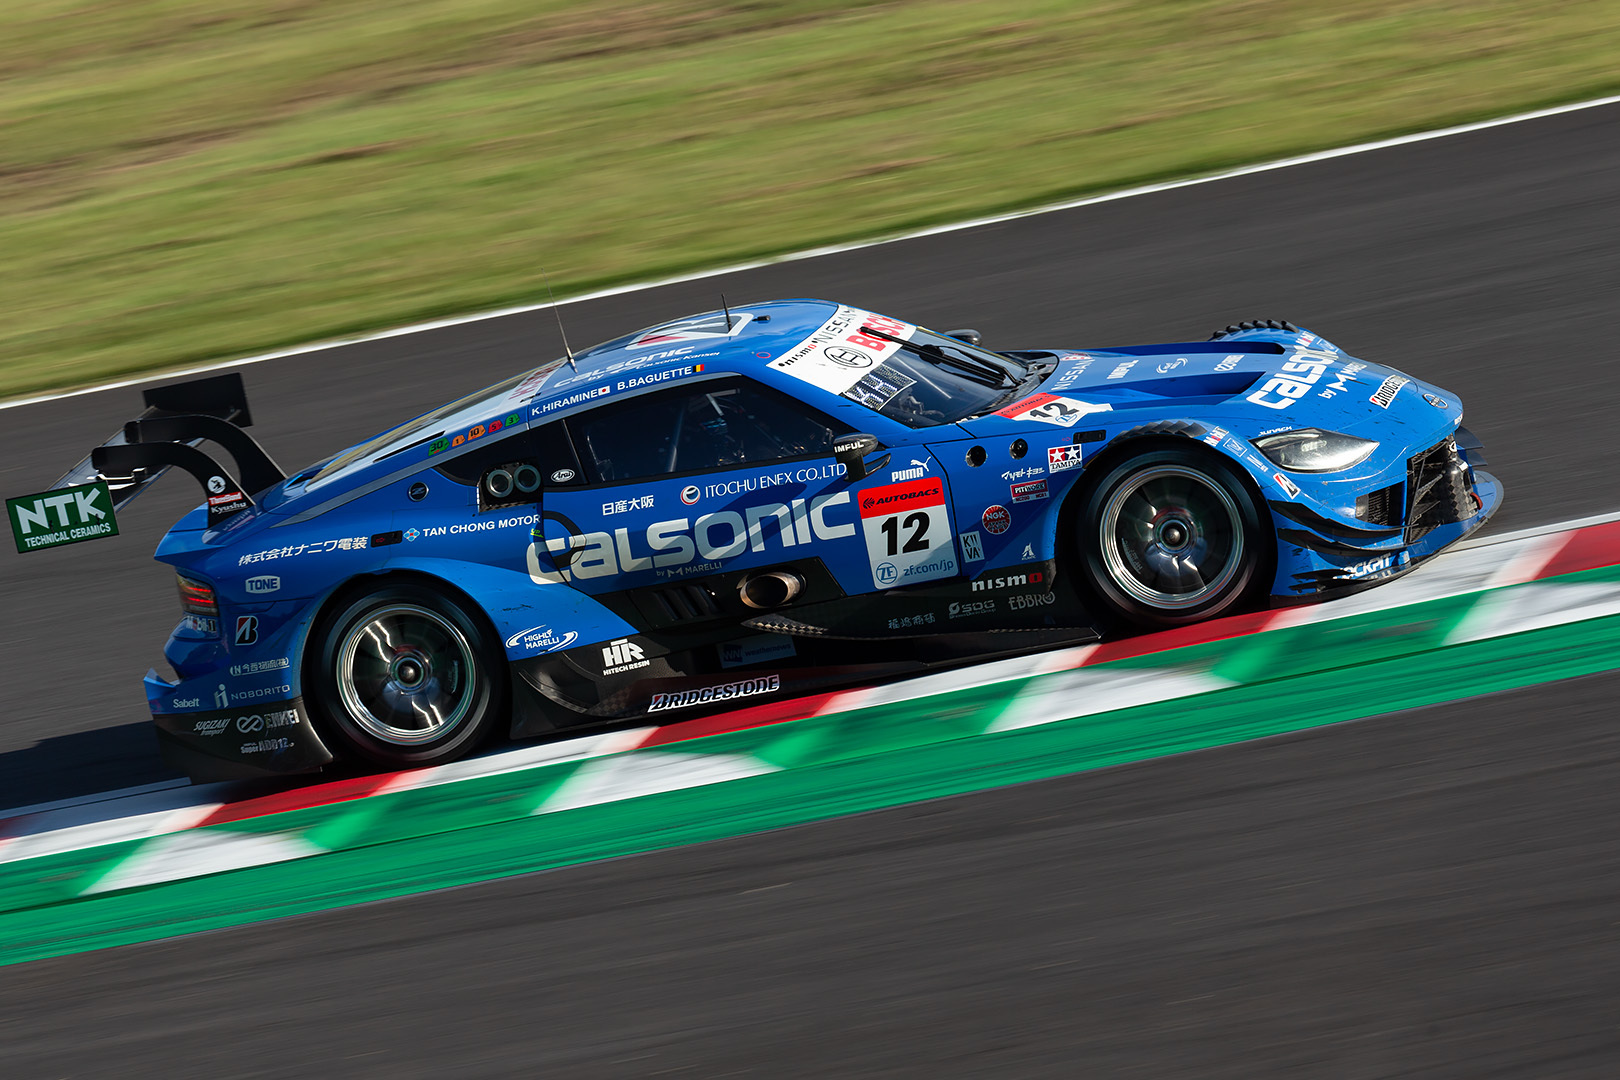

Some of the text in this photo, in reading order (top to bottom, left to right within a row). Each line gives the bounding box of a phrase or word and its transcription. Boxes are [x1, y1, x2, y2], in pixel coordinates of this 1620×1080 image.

[617, 365, 693, 391] B.BAGUETTE
[531, 389, 599, 416] K.HIRAMINE
[1029, 402, 1080, 420] 12
[1050, 459, 1081, 470] TAMIYA
[891, 466, 924, 482] PUMA
[705, 478, 757, 498] ITOCHU
[760, 472, 793, 490] ENEX
[876, 487, 940, 505] AUTOBACS
[15, 487, 106, 534] NTK
[211, 502, 247, 514] Kyushu
[602, 495, 655, 516] 日産大阪
[986, 510, 1005, 520] NGK
[24, 522, 111, 548] TECHNICAL CERAMICS
[423, 514, 541, 538] TAN CHONG MOTOR
[881, 511, 930, 556] 12
[238, 536, 369, 566] 株式会社ナニワ電装
[685, 562, 723, 574] MARELLI
[878, 567, 894, 581] ZF
[903, 559, 954, 577] zf.com/jp
[1333, 552, 1392, 579] OCKPIT
[247, 578, 278, 591] TONE
[971, 572, 1043, 592] nismo
[524, 629, 552, 643] HIGHLY
[525, 637, 559, 650] MARELLI
[603, 660, 650, 676] HITECH RESIN
[231, 684, 291, 700] NOBORITO
[647, 674, 780, 713] BRIDGESTONE
